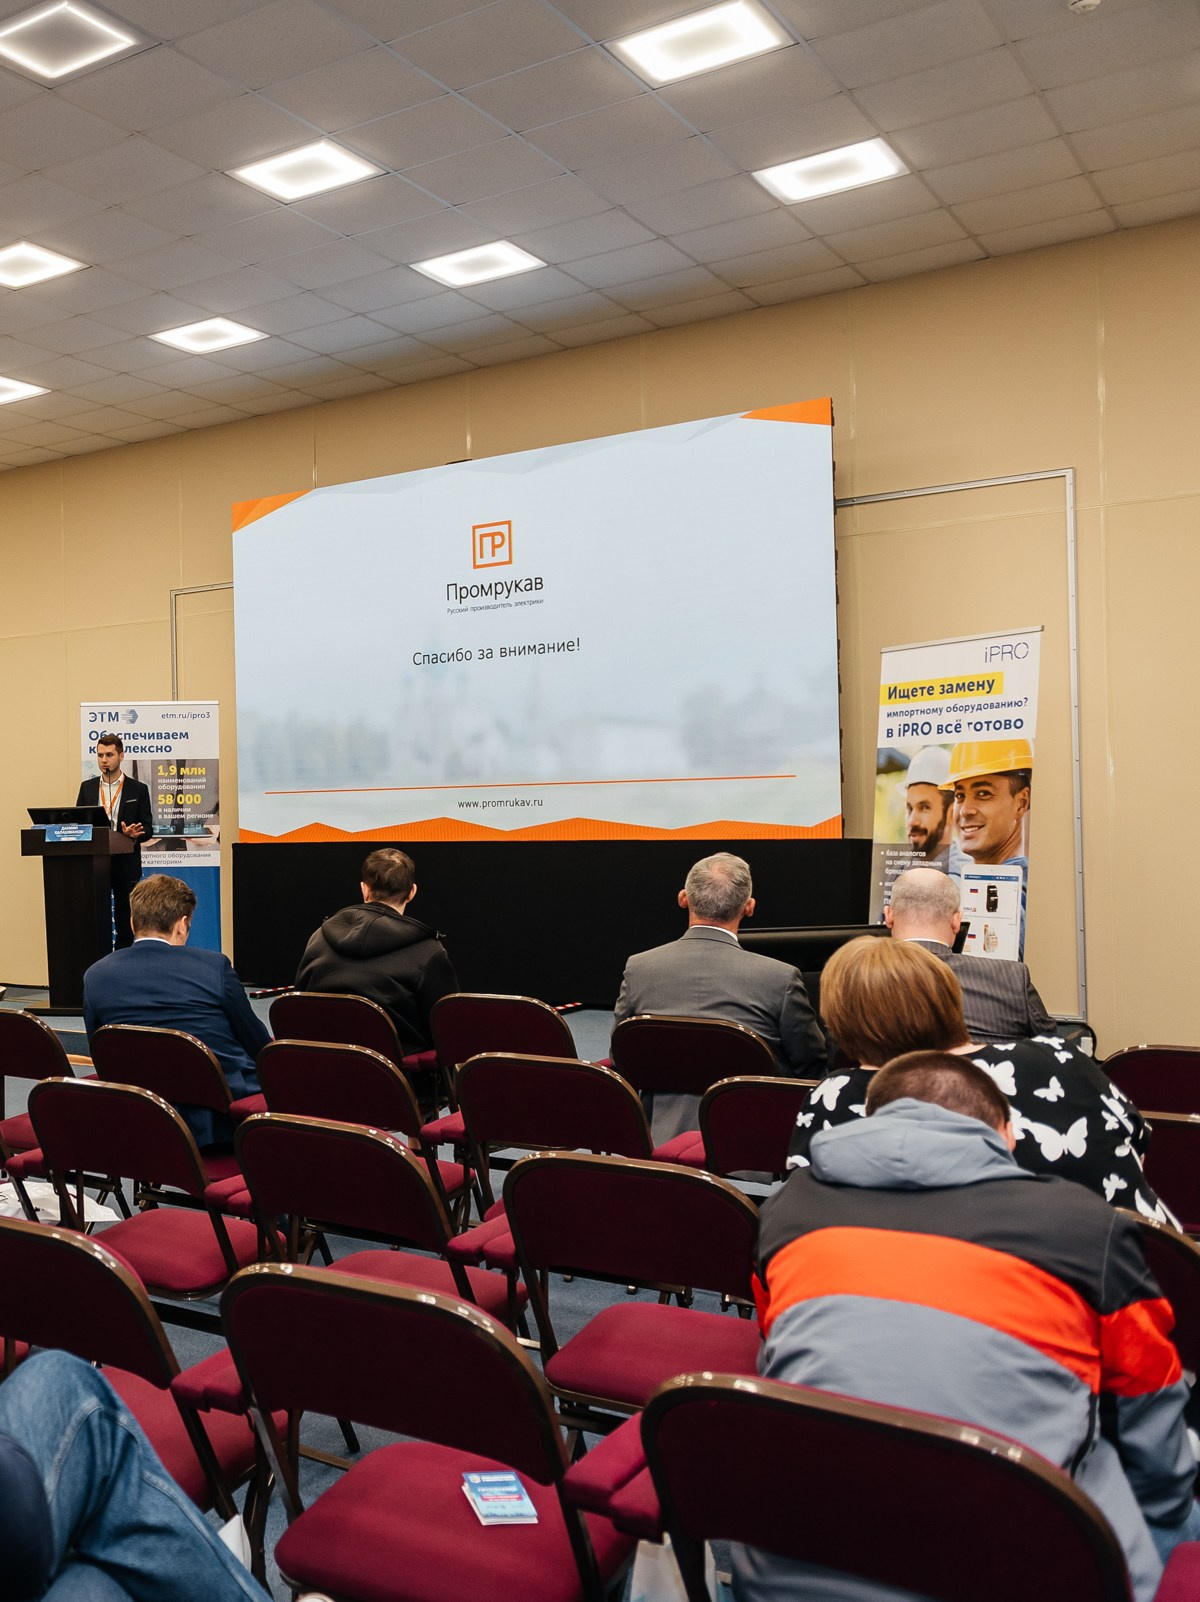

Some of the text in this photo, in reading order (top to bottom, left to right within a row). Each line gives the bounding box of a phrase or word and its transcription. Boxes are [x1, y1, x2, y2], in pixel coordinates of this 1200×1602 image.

[446, 576, 544, 604] Промрукав
[447, 599, 544, 615] Русский производитель электрики
[413, 637, 580, 665] Спасибо за внимание!
[984, 642, 1029, 663] iPRO
[887, 678, 995, 700] Ищете замену
[886, 697, 1029, 719] импортному оборудованию?
[88, 711, 119, 723] ЭТМ
[161, 711, 211, 721] etm.ru/ipro3
[886, 718, 1024, 738] в iPRO всё готово
[88, 730, 189, 741] Обспечиваем
[88, 744, 173, 754] клексно
[157, 765, 206, 777] 1,9 млн
[158, 793, 202, 805] 58 000
[458, 798, 543, 809] www.promrukav.ru
[886, 849, 898, 857] база
